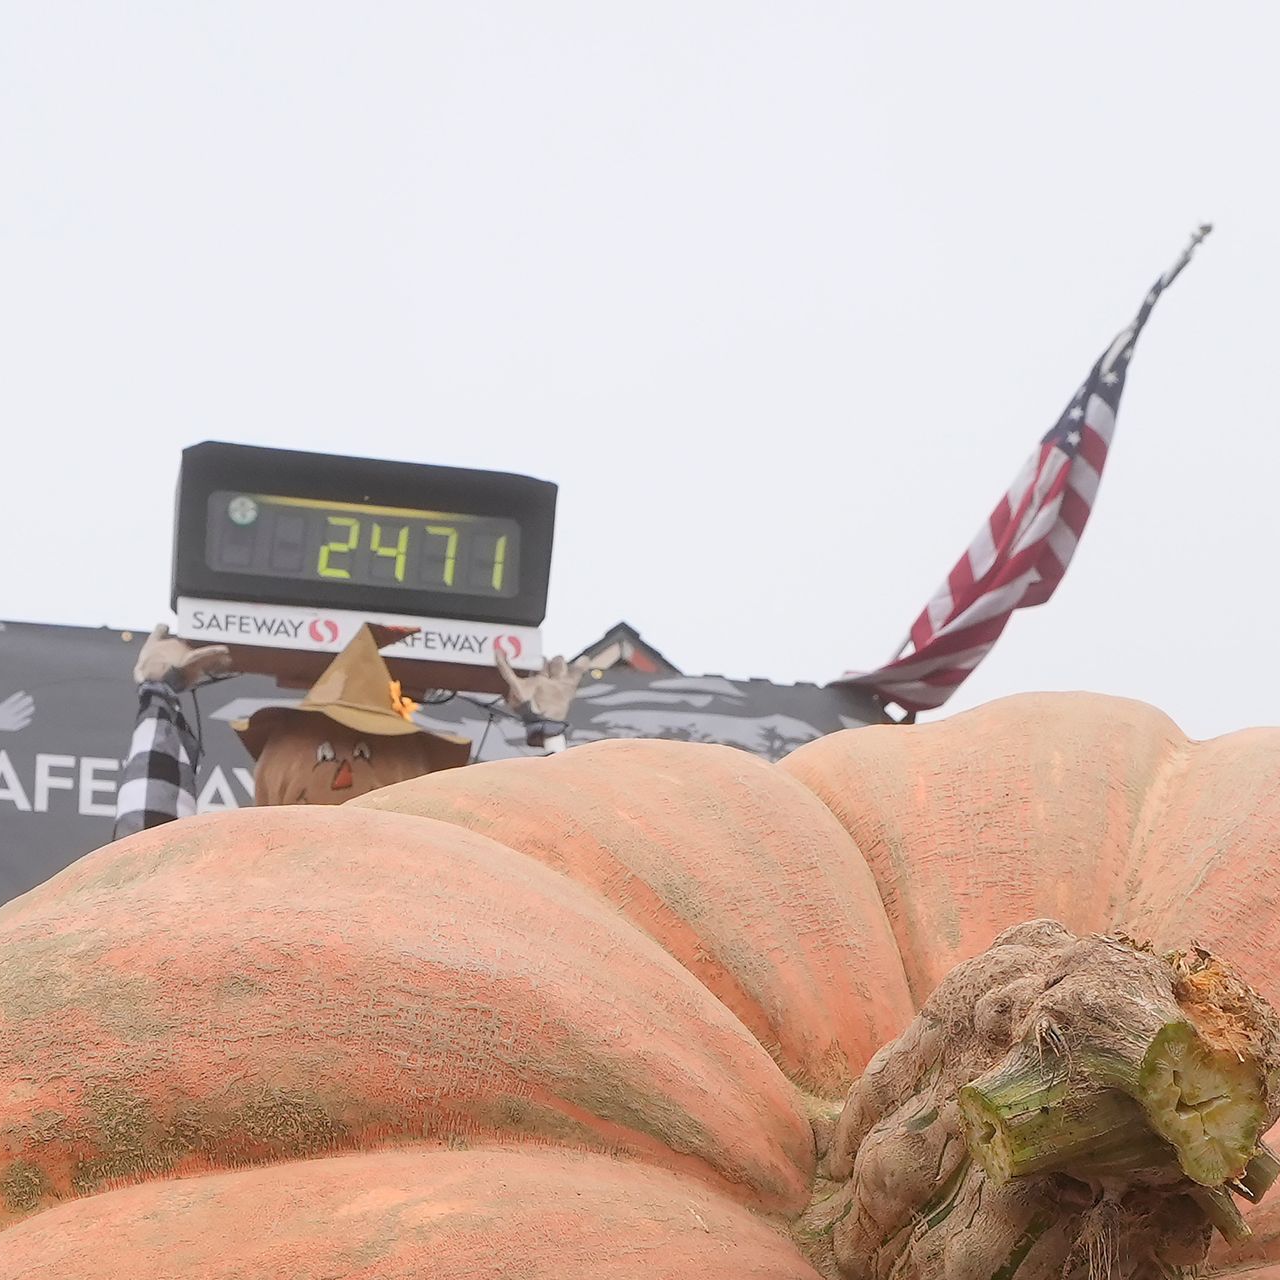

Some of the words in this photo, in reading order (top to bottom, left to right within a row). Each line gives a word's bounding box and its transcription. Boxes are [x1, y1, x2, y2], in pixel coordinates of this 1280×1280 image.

[317, 516, 507, 592] 2471
[191, 611, 304, 639] SAFEWAY
[399, 629, 488, 654] FEWAY
